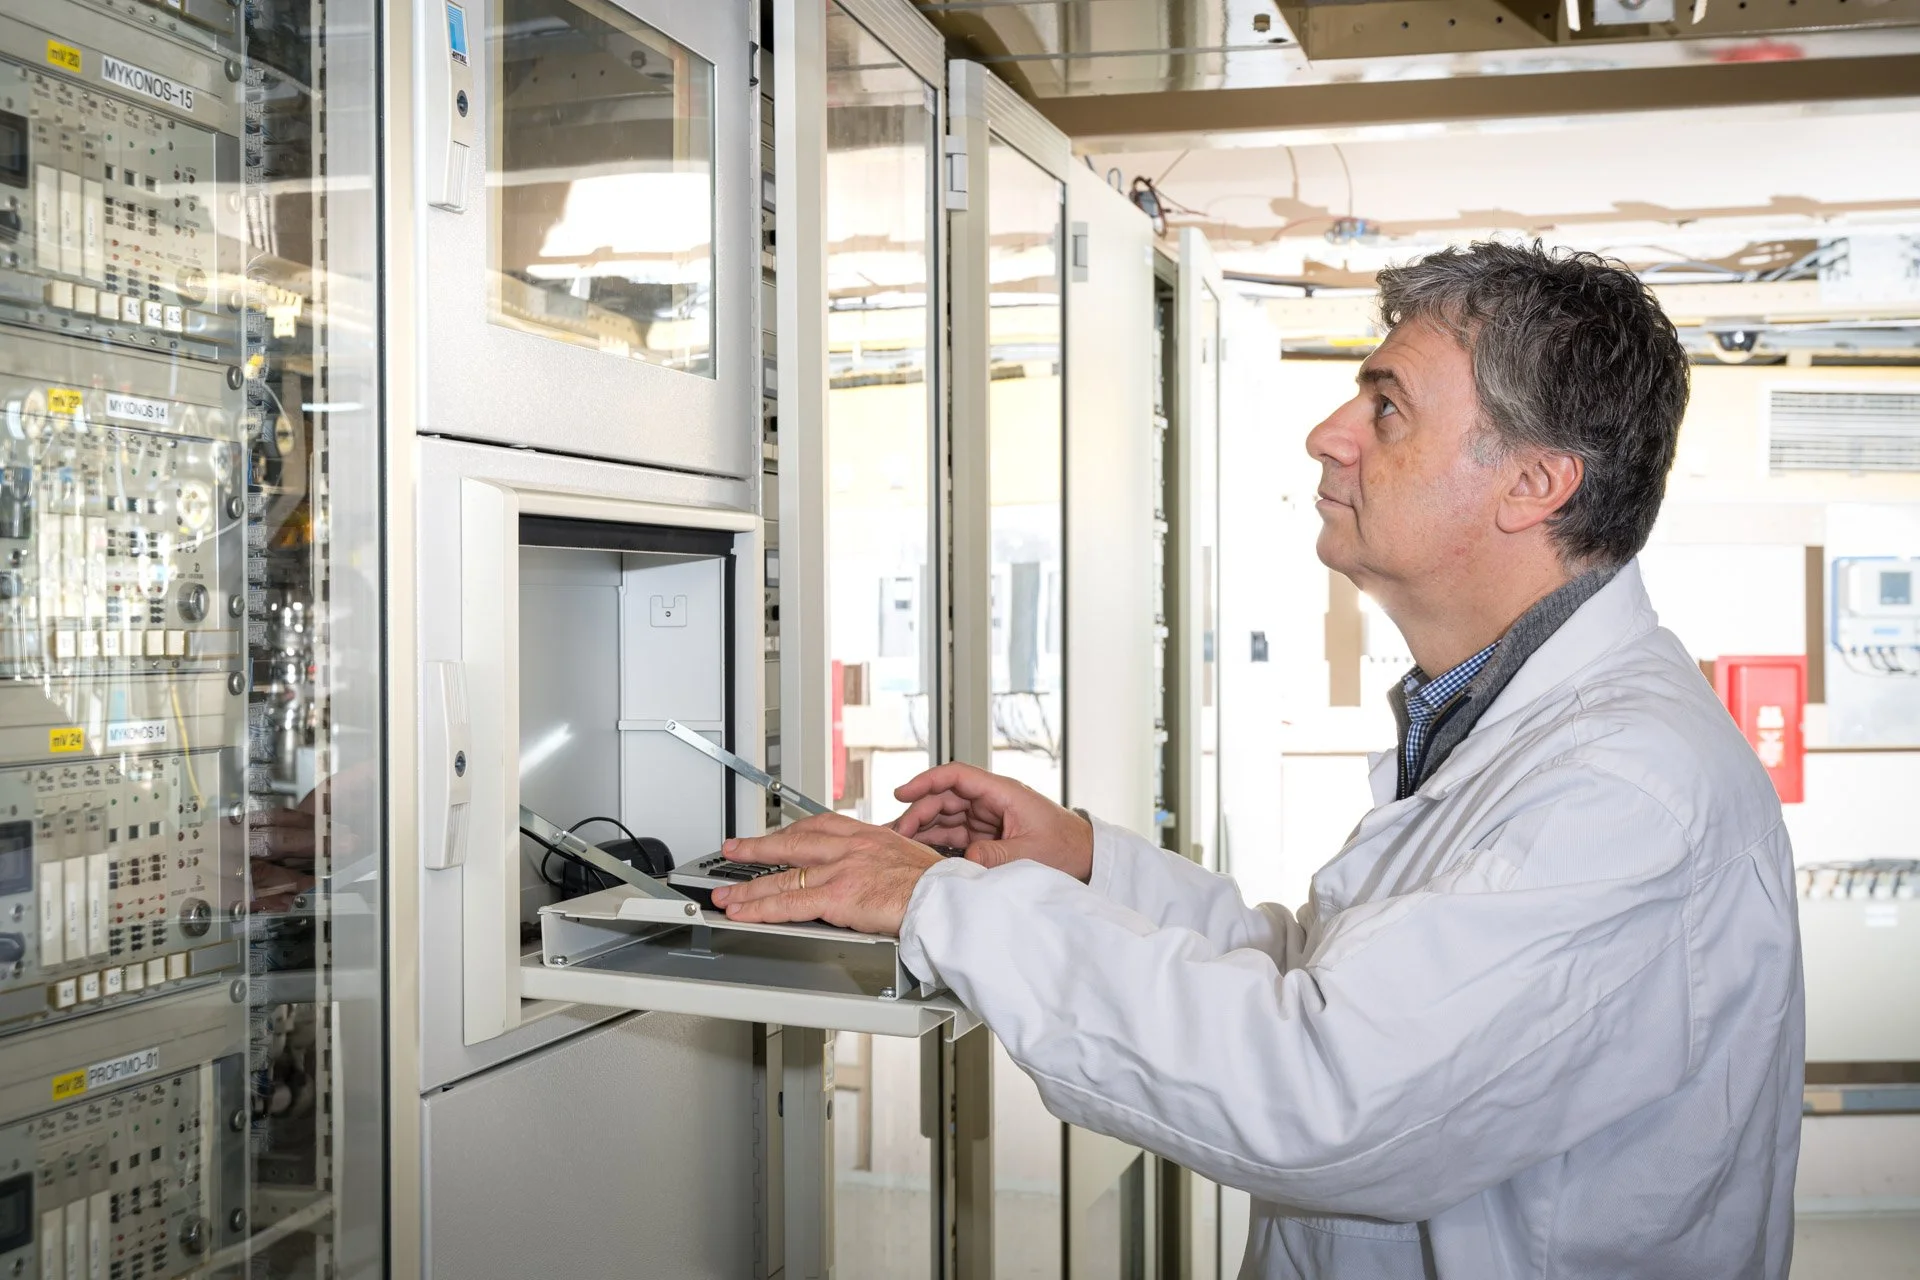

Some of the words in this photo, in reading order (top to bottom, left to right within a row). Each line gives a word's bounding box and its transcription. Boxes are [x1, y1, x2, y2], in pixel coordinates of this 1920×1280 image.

[104, 59, 193, 109] MYKONOS-15
[155, 407, 165, 418] 14
[155, 725, 165, 737] 14
[88, 1052, 158, 1086] PROFIMO-01
